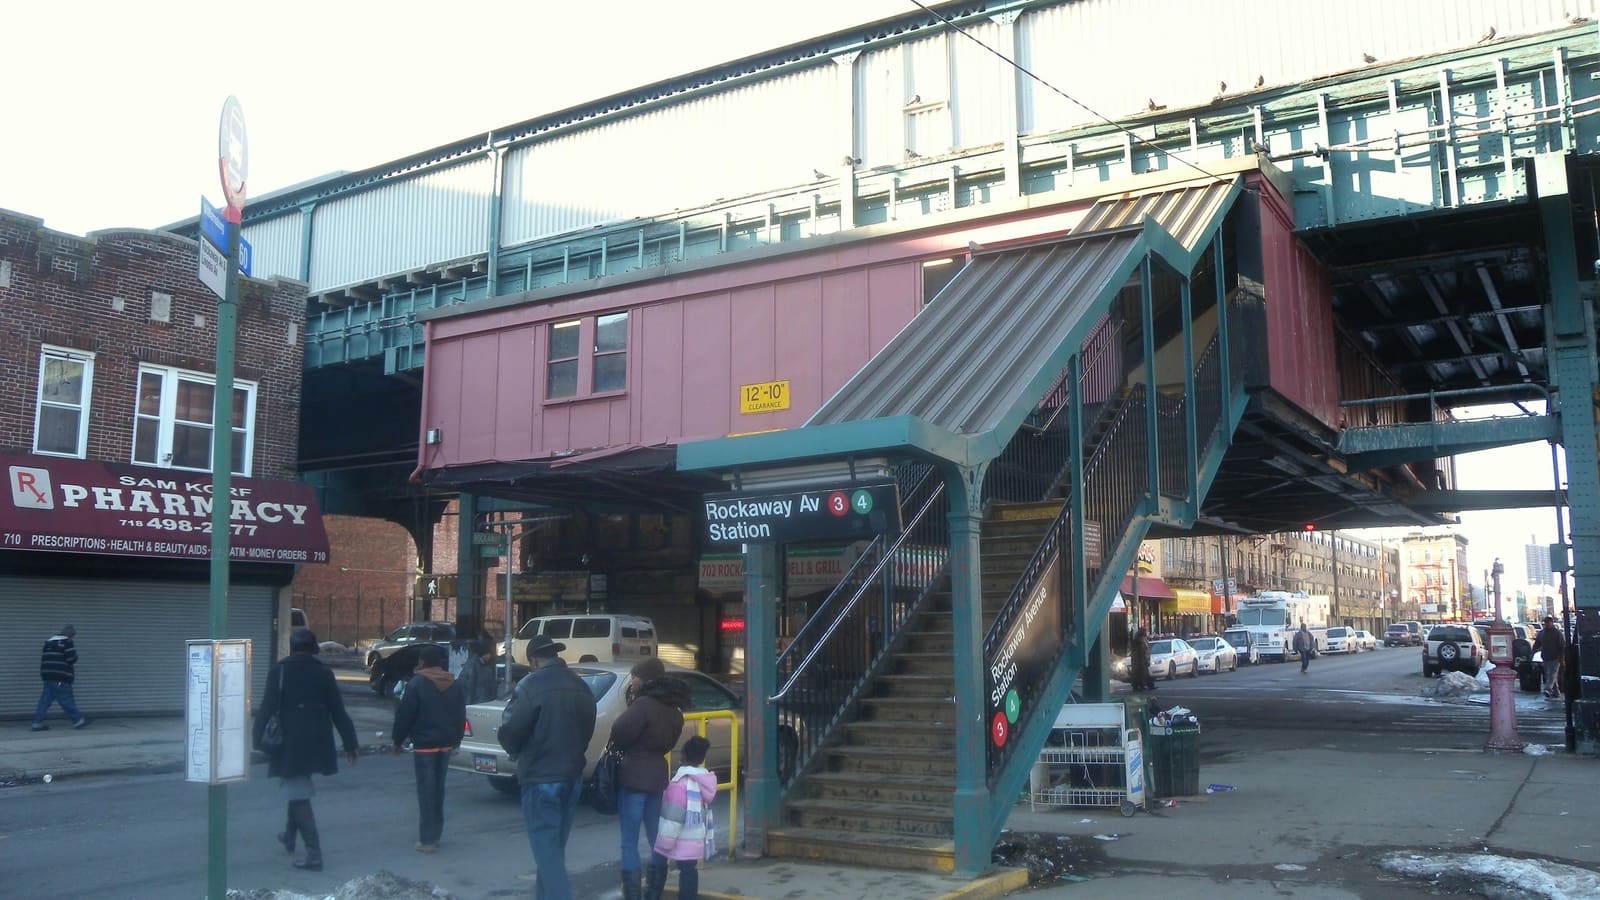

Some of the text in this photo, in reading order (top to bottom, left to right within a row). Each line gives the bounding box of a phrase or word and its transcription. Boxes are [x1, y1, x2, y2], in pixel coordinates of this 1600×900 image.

[748, 400, 782, 411] CLEARANCE
[119, 476, 177, 490] SAM
[705, 494, 867, 521] Rockaway Av 3 4
[119, 517, 258, 536] 718 498-277
[708, 523, 771, 541] Station
[4, 533, 326, 562] 710 PRESCRIPTIONS HEALTH & BEAUTY AIDS ATM MONEY ORDERS 710
[701, 561, 717, 577] 702
[788, 560, 804, 576] ELI
[815, 558, 842, 576] GRILL
[991, 586, 1047, 685] Rockaway Avenue
[991, 661, 1018, 707] Station
